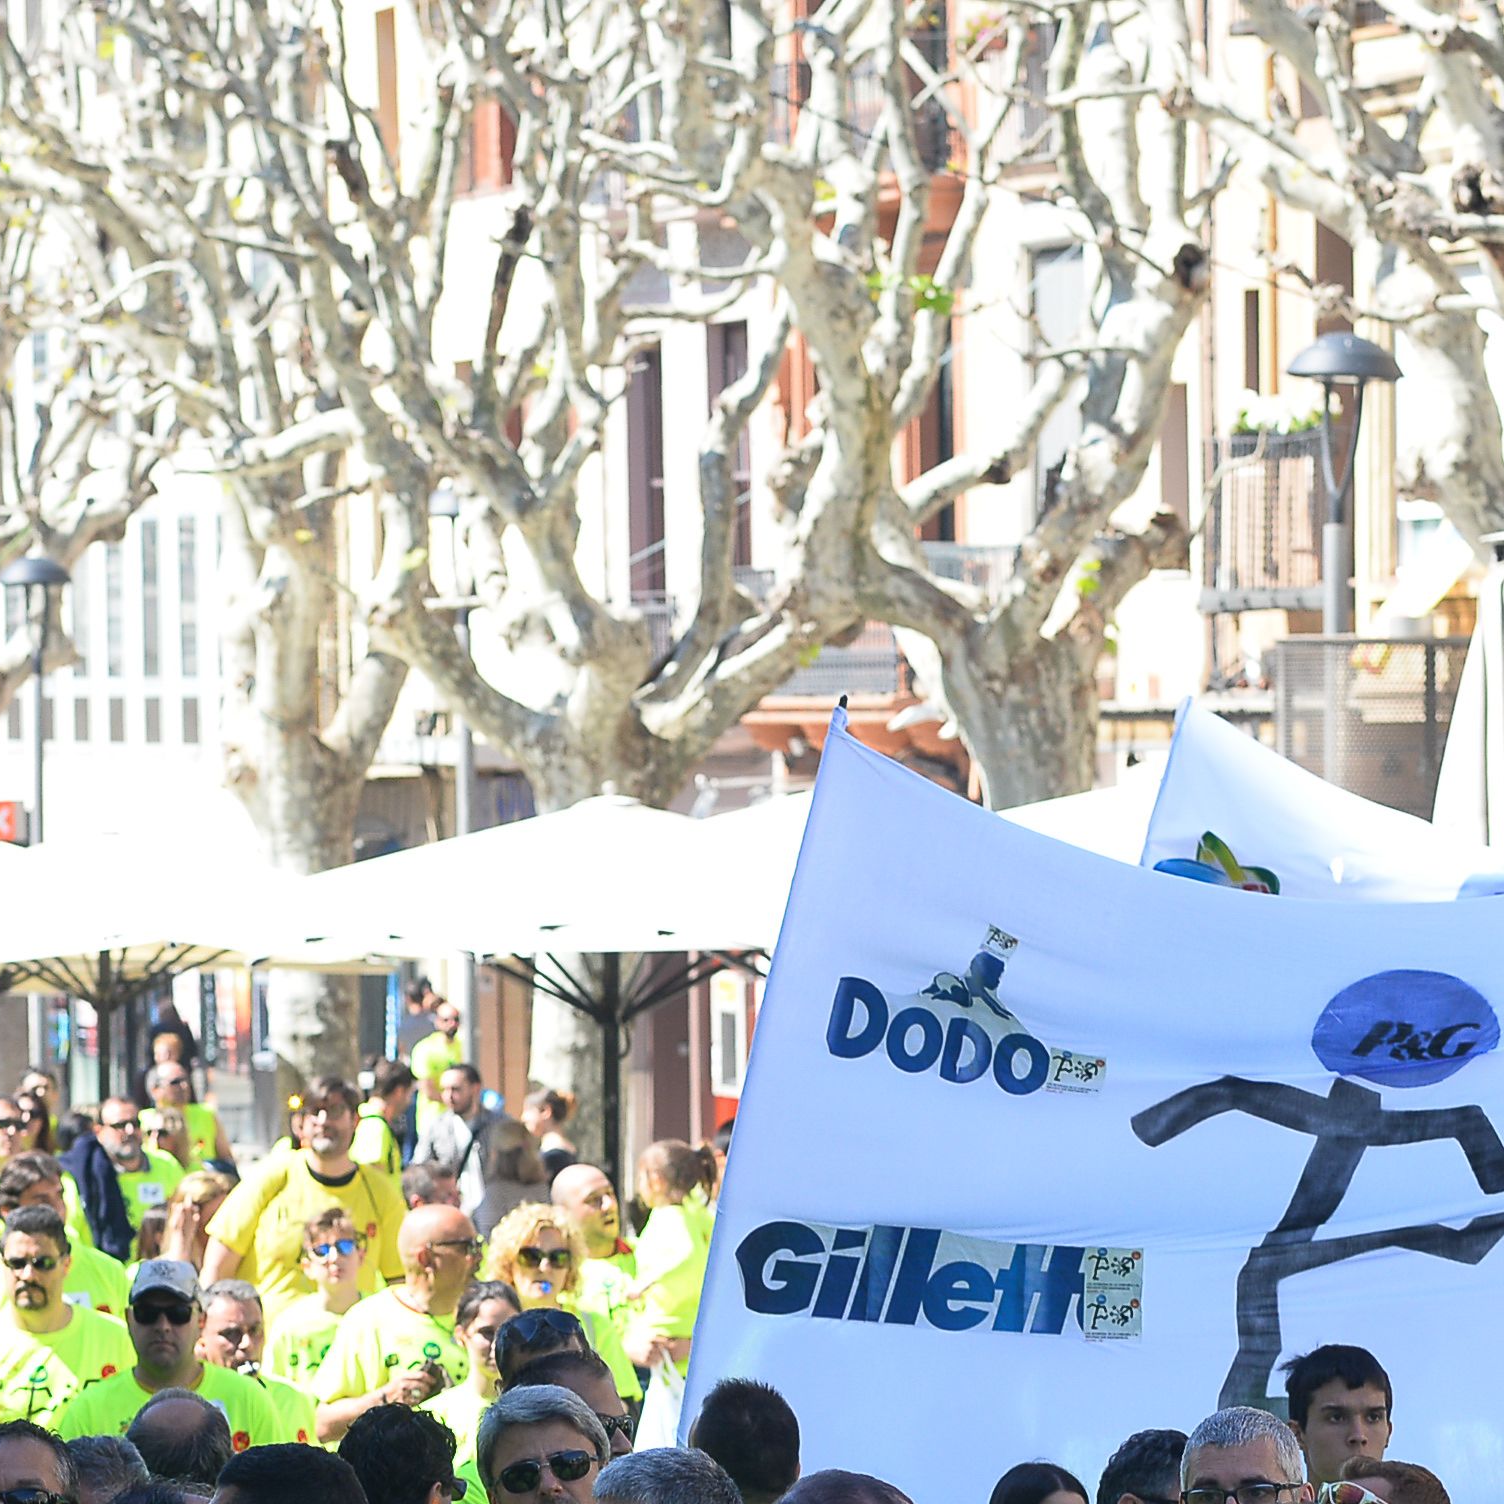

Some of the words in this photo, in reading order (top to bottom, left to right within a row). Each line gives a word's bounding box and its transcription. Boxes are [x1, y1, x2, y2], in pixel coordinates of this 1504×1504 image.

[827, 976, 1050, 1096] DODO
[1351, 1021, 1481, 1062] P&G
[736, 1220, 1085, 1336] Gillett
